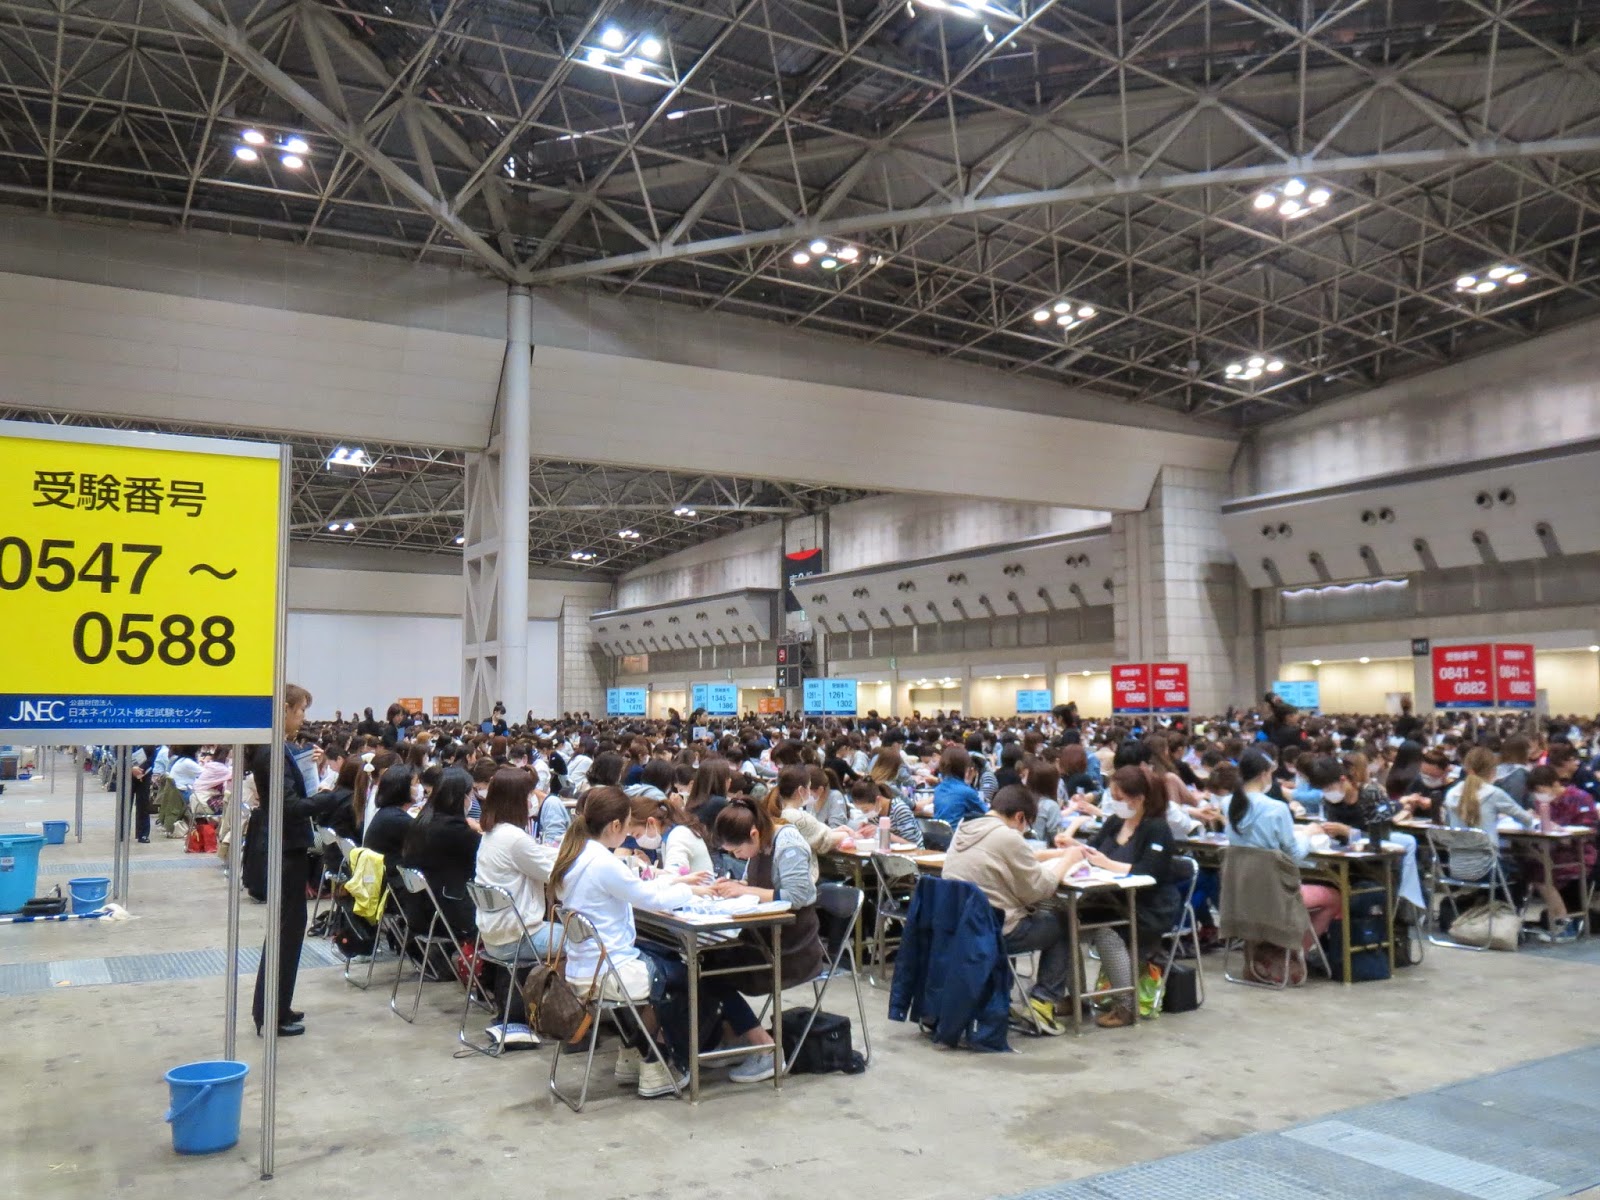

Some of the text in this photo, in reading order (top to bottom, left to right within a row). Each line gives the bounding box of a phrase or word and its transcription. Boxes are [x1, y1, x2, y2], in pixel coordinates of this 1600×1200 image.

[32, 470, 207, 518] 受験番号
[0, 536, 163, 595] 0547
[73, 611, 236, 666] 0588
[1439, 667, 1469, 680] 0841
[1453, 682, 1487, 695] 0882
[9, 700, 65, 722] JNEC
[68, 707, 212, 718] 日本ネイリスト検定試験センター
